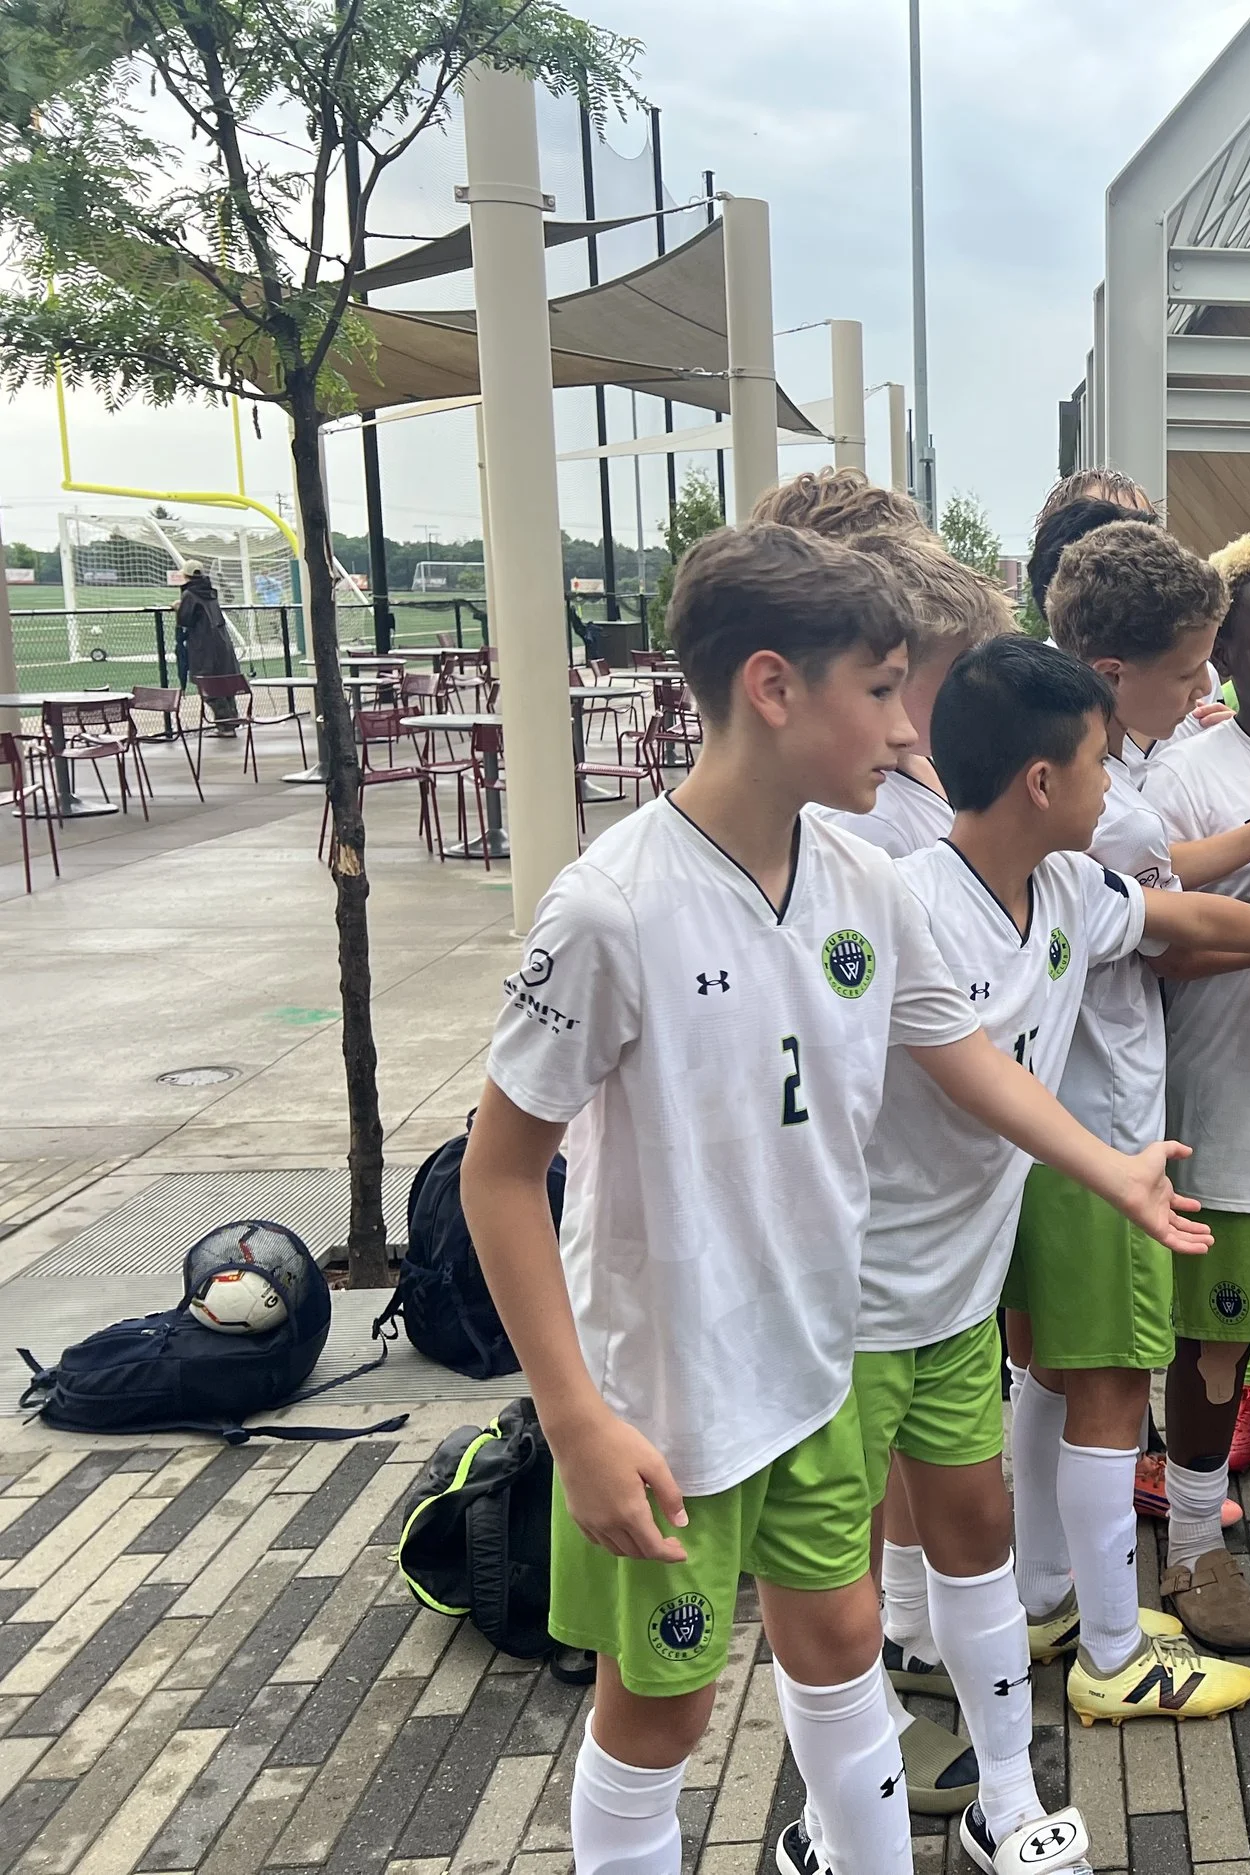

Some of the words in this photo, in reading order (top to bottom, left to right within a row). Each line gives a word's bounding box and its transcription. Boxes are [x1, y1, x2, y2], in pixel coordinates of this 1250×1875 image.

[825, 931, 866, 953] FUSION
[828, 976, 860, 997] SOCCER
[781, 1035, 809, 1126] 2
[659, 1595, 706, 1615] FUSION
[652, 1636, 688, 1659] SOCCER
[693, 1629, 711, 1654] CLUB
